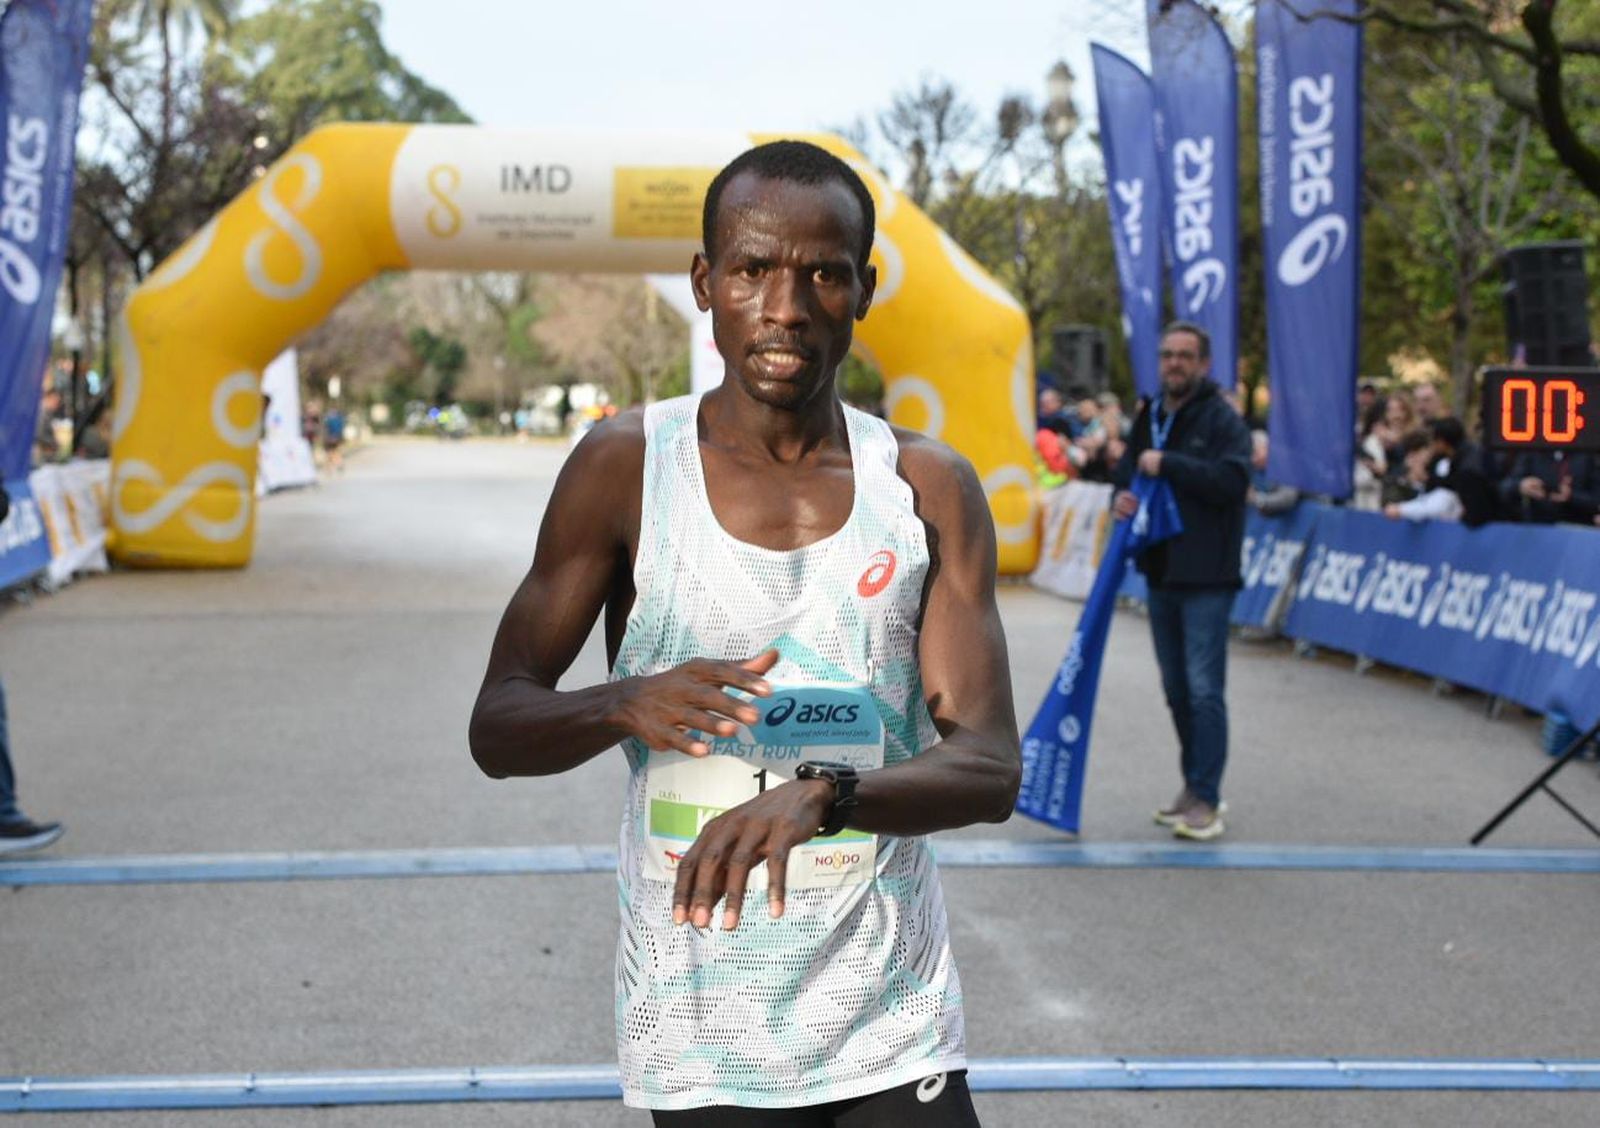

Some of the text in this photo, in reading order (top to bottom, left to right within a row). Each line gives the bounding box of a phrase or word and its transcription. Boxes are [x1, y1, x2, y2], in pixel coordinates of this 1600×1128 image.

[2, 114, 48, 243] asics
[500, 164, 573, 194] IMD
[796, 704, 860, 724] asics
[762, 743, 802, 760] RUN
